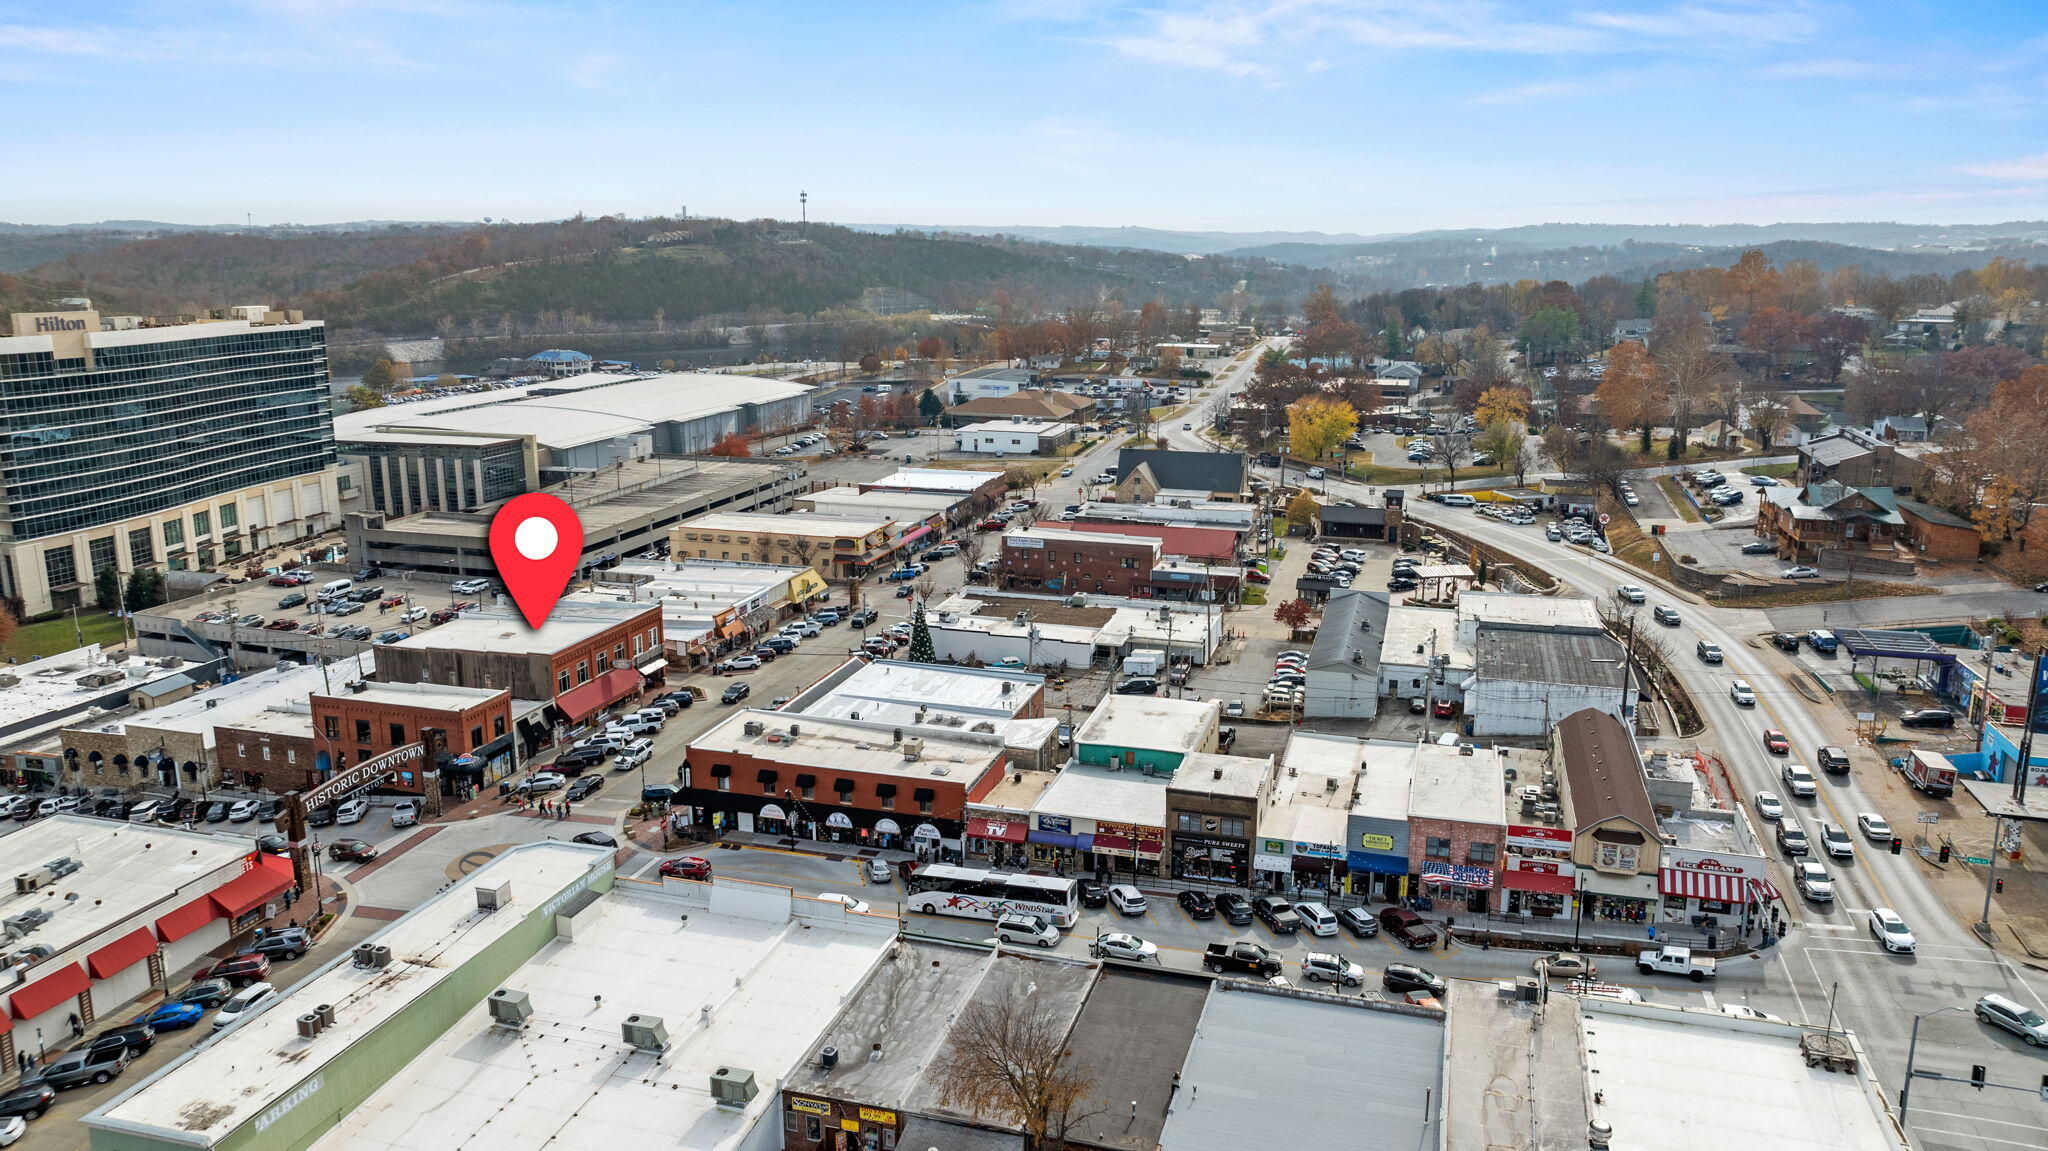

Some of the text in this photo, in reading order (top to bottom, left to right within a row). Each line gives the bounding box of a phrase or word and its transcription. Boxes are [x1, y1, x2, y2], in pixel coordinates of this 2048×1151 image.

[35, 316, 87, 332] Hilton
[304, 744, 424, 813] HISTORIC DOWNTOWN
[351, 778, 385, 800] BRANSON
[987, 825, 1006, 836] TV
[1221, 841, 1245, 849] SWEETS
[1452, 864, 1490, 875] BRANSON
[1701, 864, 1735, 873] CREAM
[1451, 872, 1490, 885] QUILTS
[542, 862, 612, 916] VICTORIAN HOUSE
